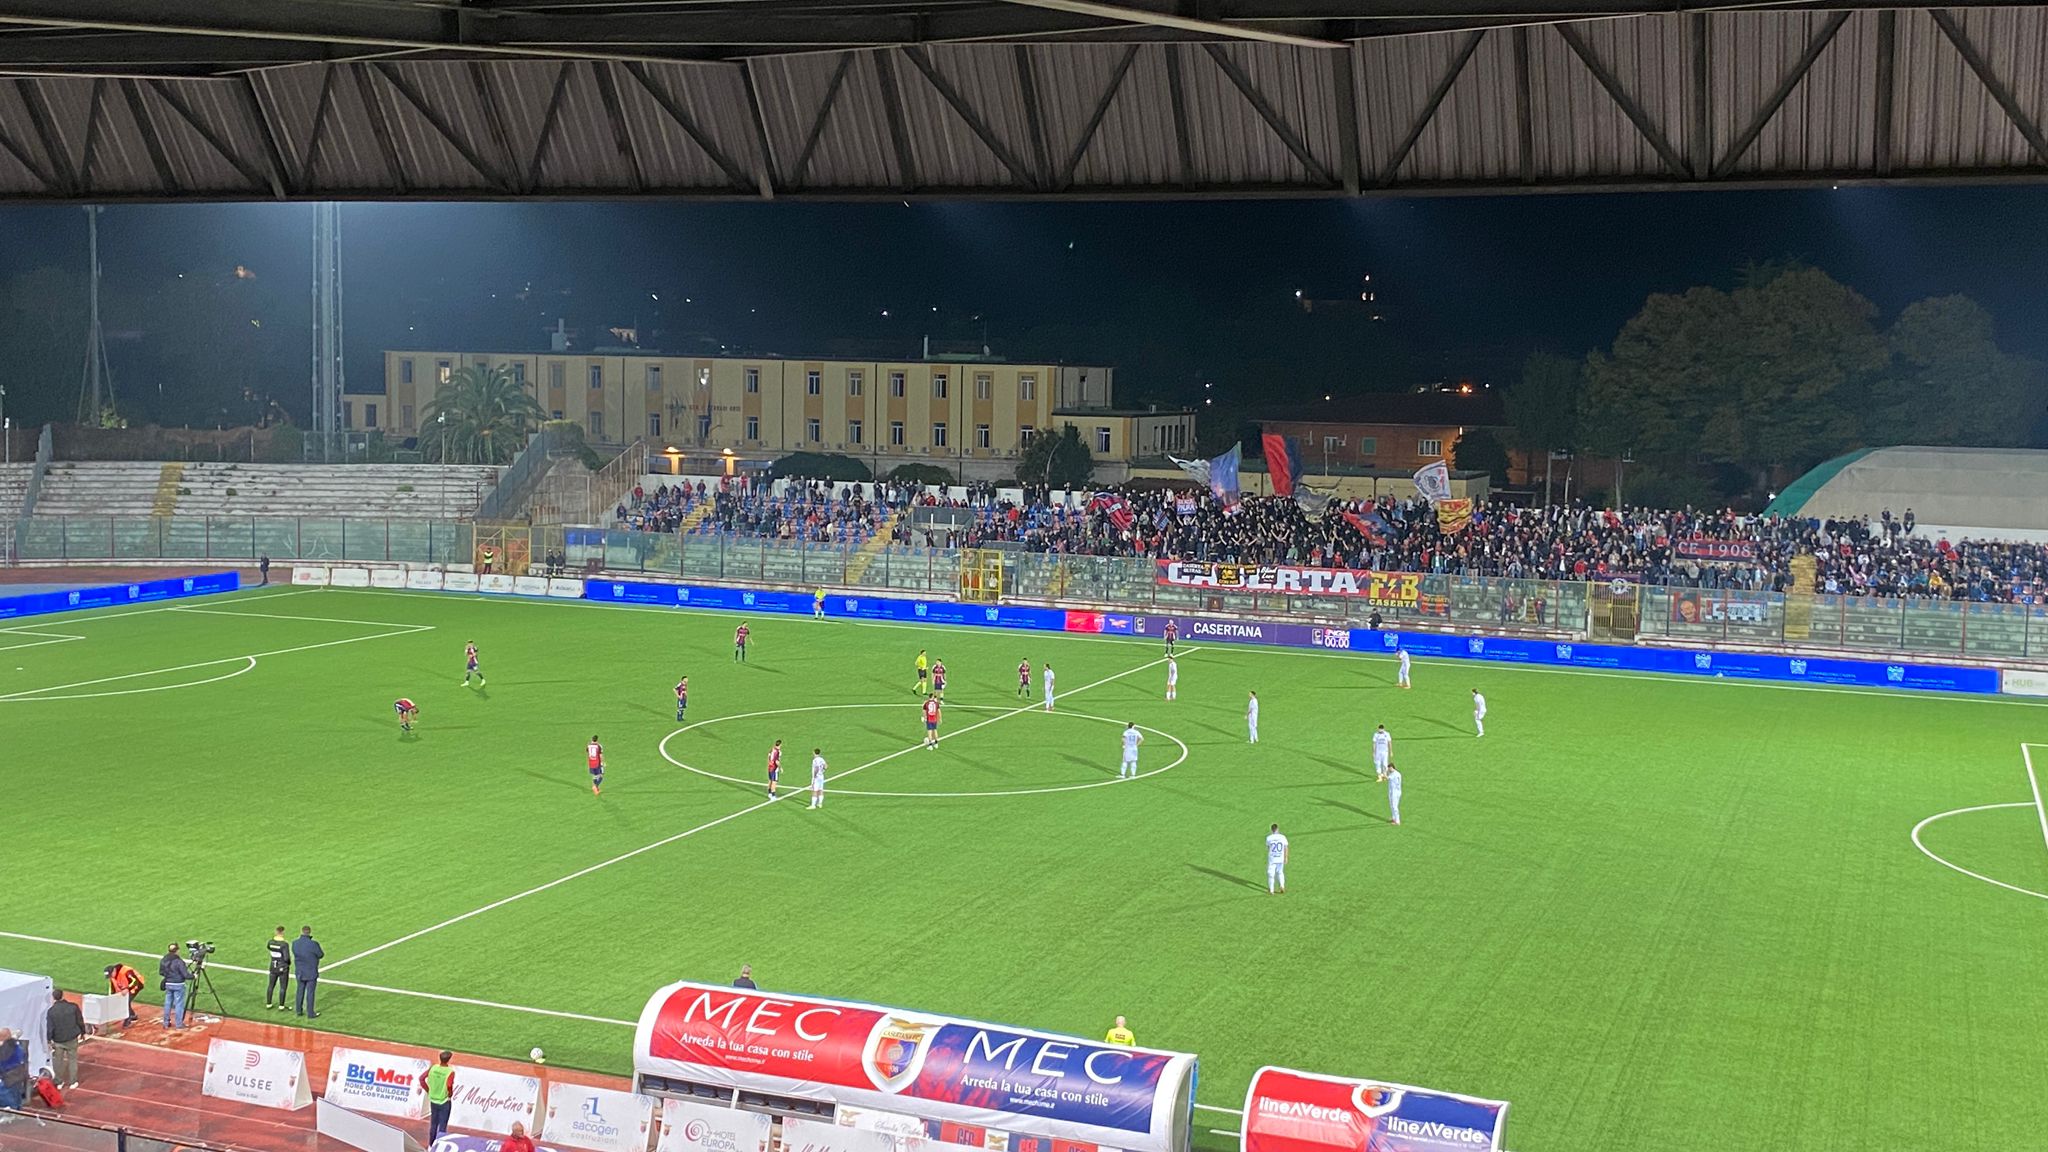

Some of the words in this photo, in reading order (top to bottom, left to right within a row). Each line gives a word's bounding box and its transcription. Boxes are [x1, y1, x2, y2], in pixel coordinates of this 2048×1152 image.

[1708, 543, 1751, 558] 1908
[1368, 598, 1418, 609] CASERTA
[1193, 622, 1263, 638] CASERTANA
[1324, 636, 1350, 649] 00:00
[1271, 842, 1283, 853] 20
[683, 992, 843, 1042] MEC
[680, 1033, 714, 1048] Arreda
[717, 1036, 727, 1049] la
[729, 1040, 745, 1052] tua
[747, 1044, 769, 1056] casa
[771, 1048, 790, 1059] con
[792, 1050, 814, 1062] stile
[962, 1030, 1134, 1085] MEC
[226, 1074, 273, 1091] PULSEE
[346, 1063, 414, 1086] BigMat
[345, 1082, 364, 1090] HOME
[376, 1086, 410, 1097] BUILDERS
[361, 1089, 408, 1102] COSTANTINO
[960, 1074, 998, 1090] Arreda
[1001, 1079, 1011, 1092] la
[1014, 1082, 1031, 1095] tua
[1034, 1086, 1058, 1099] casa
[1061, 1091, 1082, 1104] con
[1085, 1093, 1109, 1107] stile
[461, 1086, 524, 1113] Monfortino
[572, 1120, 619, 1137] sacogen
[701, 1137, 736, 1151] EUROPA
